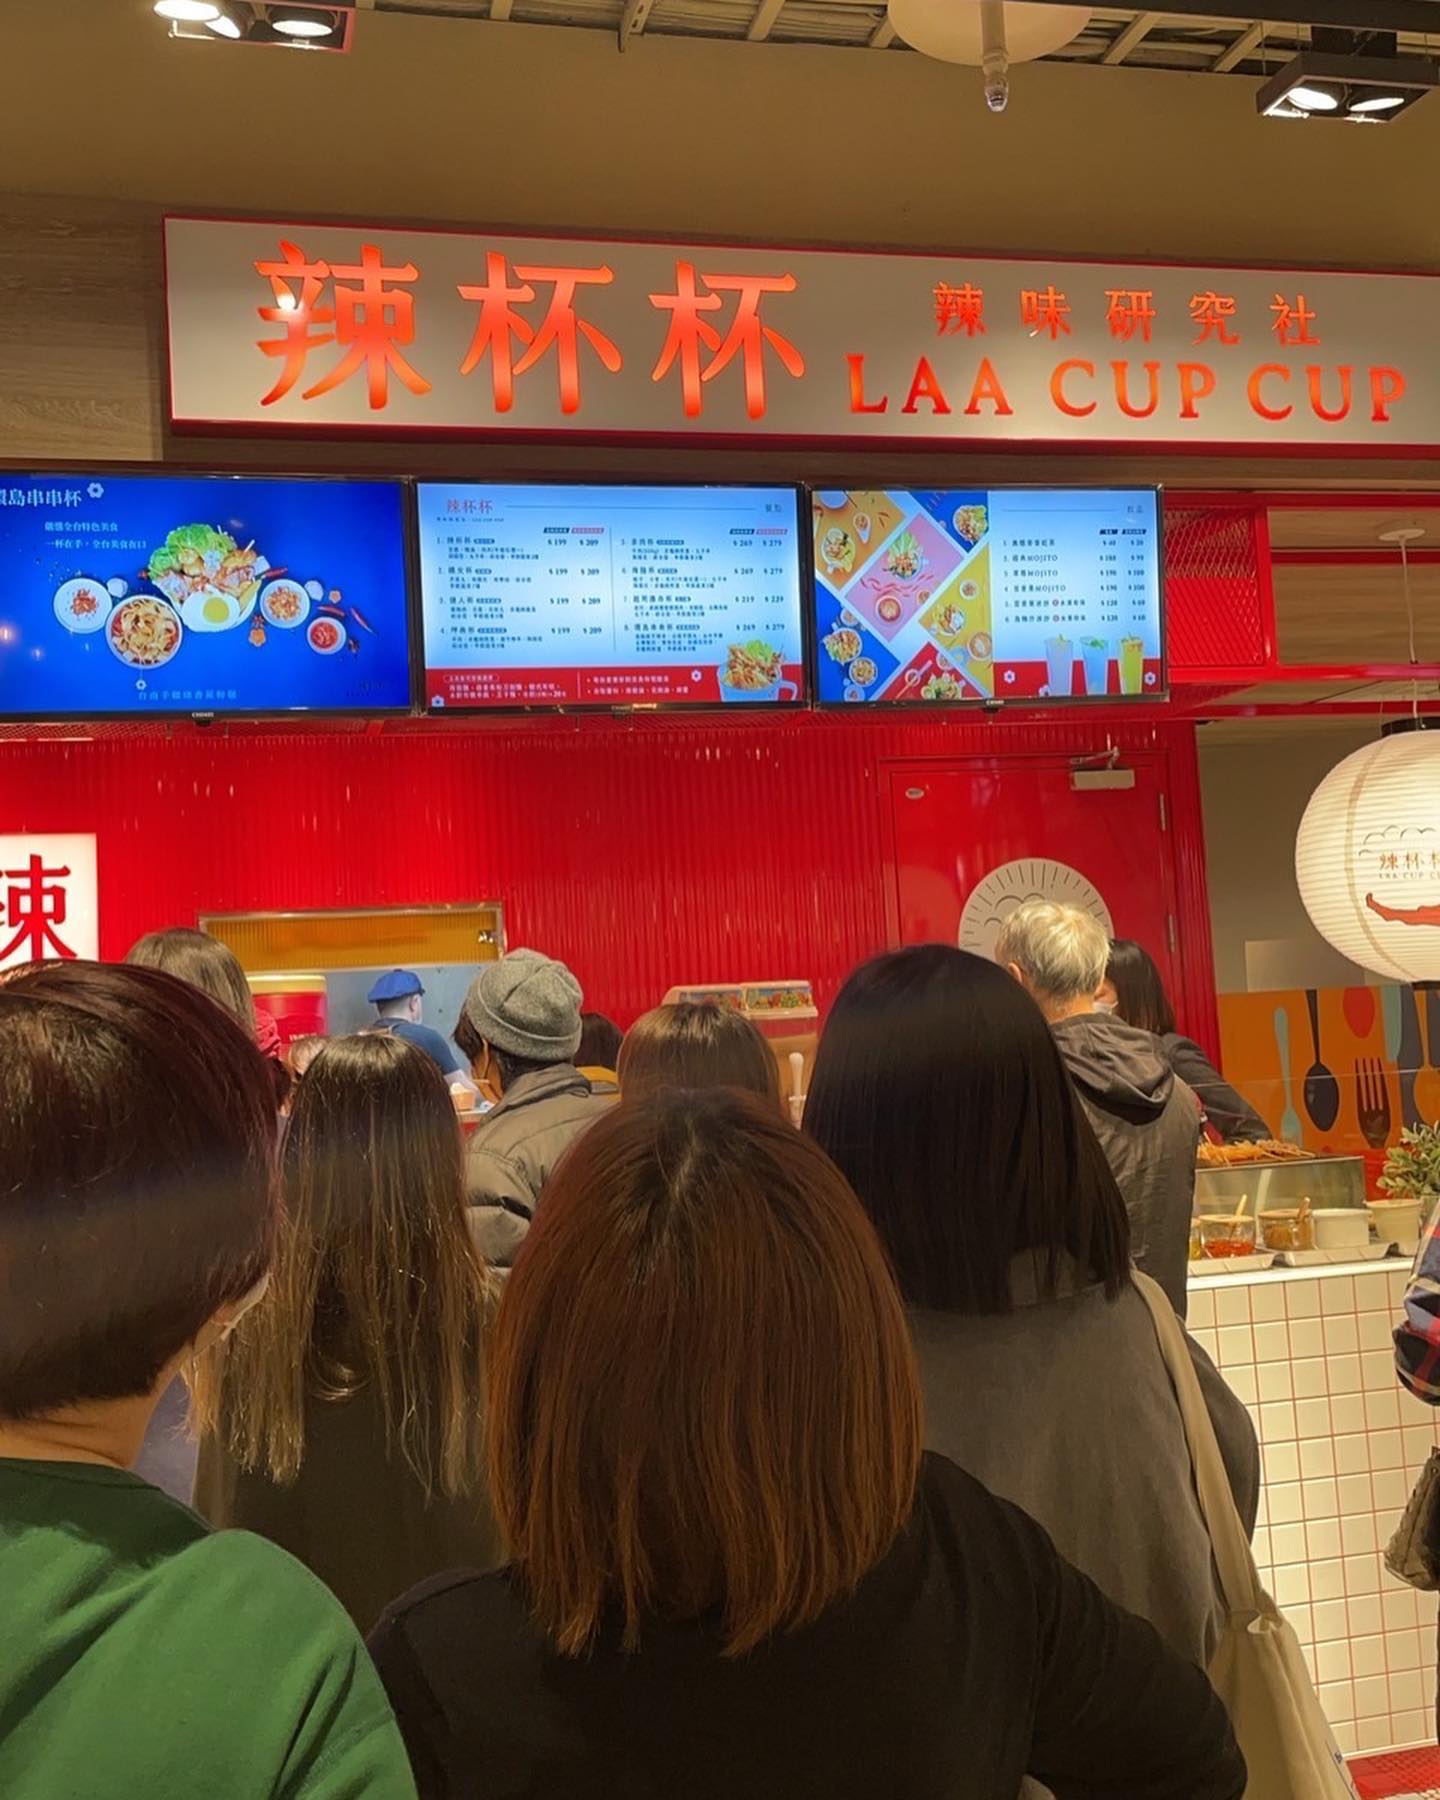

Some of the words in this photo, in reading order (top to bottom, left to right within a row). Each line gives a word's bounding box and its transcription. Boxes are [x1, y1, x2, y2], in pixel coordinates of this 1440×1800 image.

[254, 240, 805, 420] 辣杯杯
[932, 281, 1320, 347] 辣味研究社
[844, 353, 1013, 415] LAA
[1049, 358, 1217, 418] CUP
[1246, 362, 1407, 422] CUP
